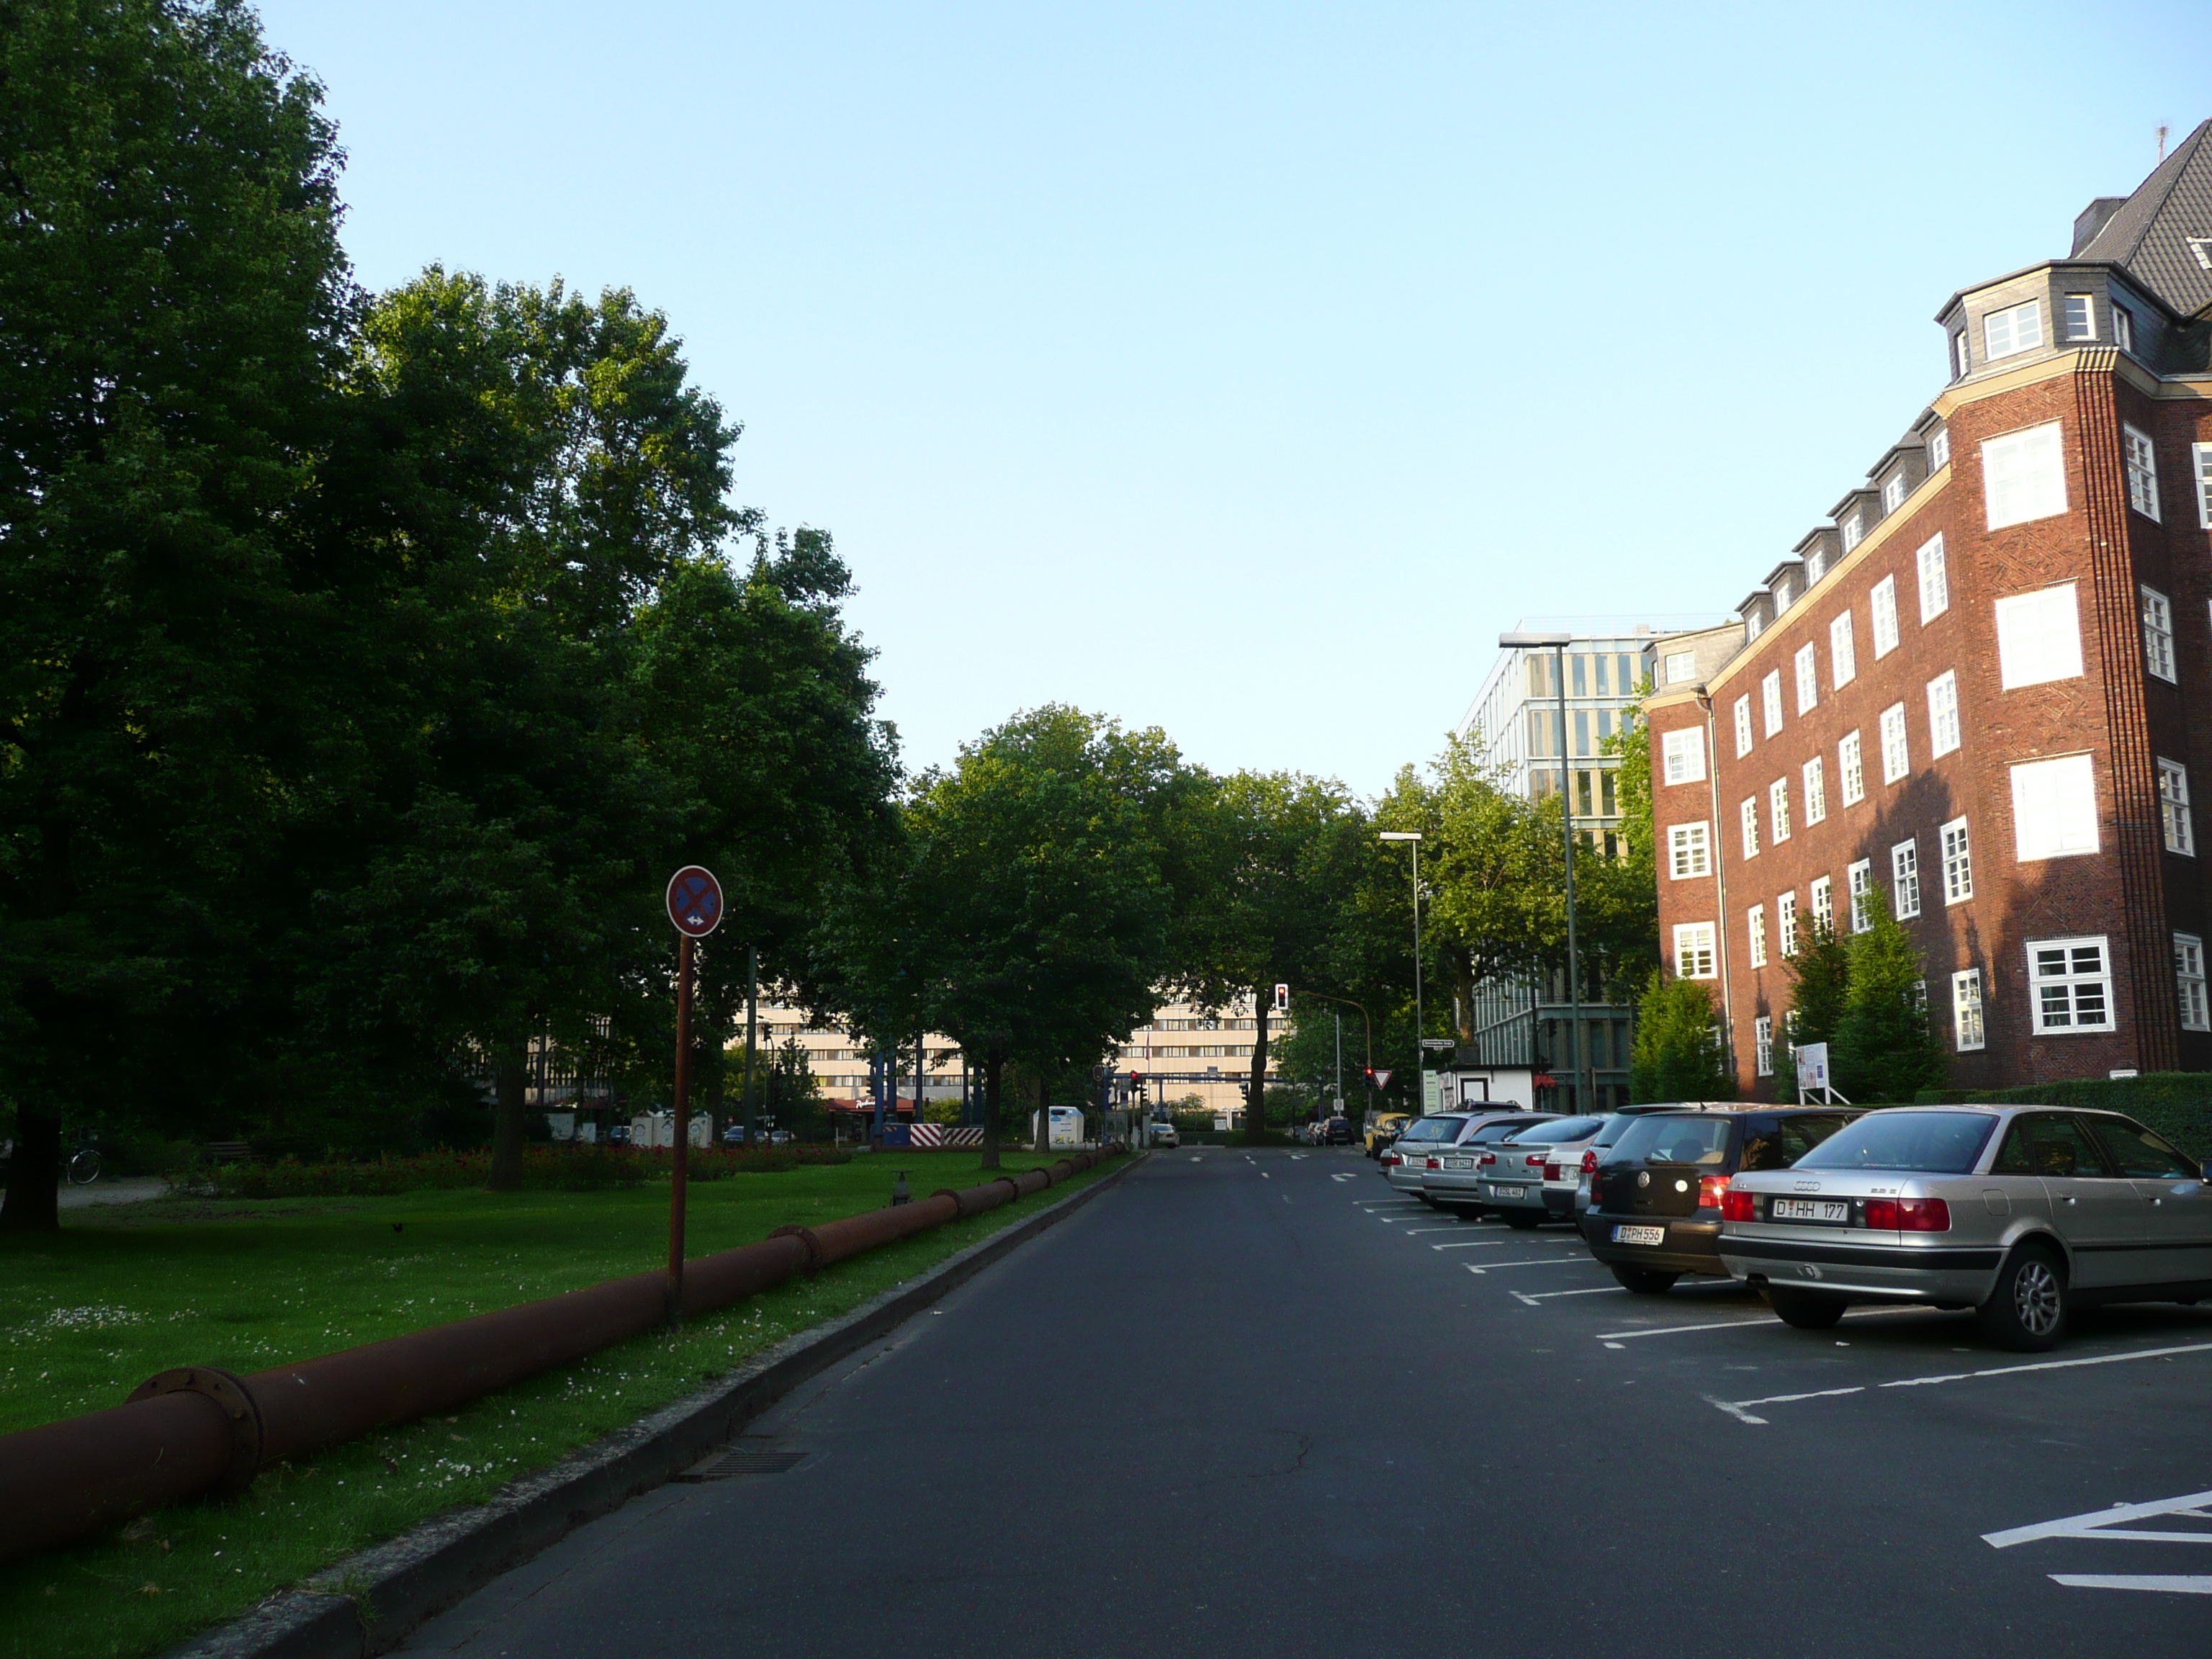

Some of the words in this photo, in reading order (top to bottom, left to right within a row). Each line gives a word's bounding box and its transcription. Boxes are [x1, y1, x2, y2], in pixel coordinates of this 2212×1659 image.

[1776, 1201, 1786, 1215] D
[1796, 1202, 1815, 1217] HH
[1824, 1203, 1844, 1218] 177
[1620, 1227, 1627, 1238] D
[1631, 1228, 1643, 1239] PH
[1643, 1228, 1660, 1240] 556
